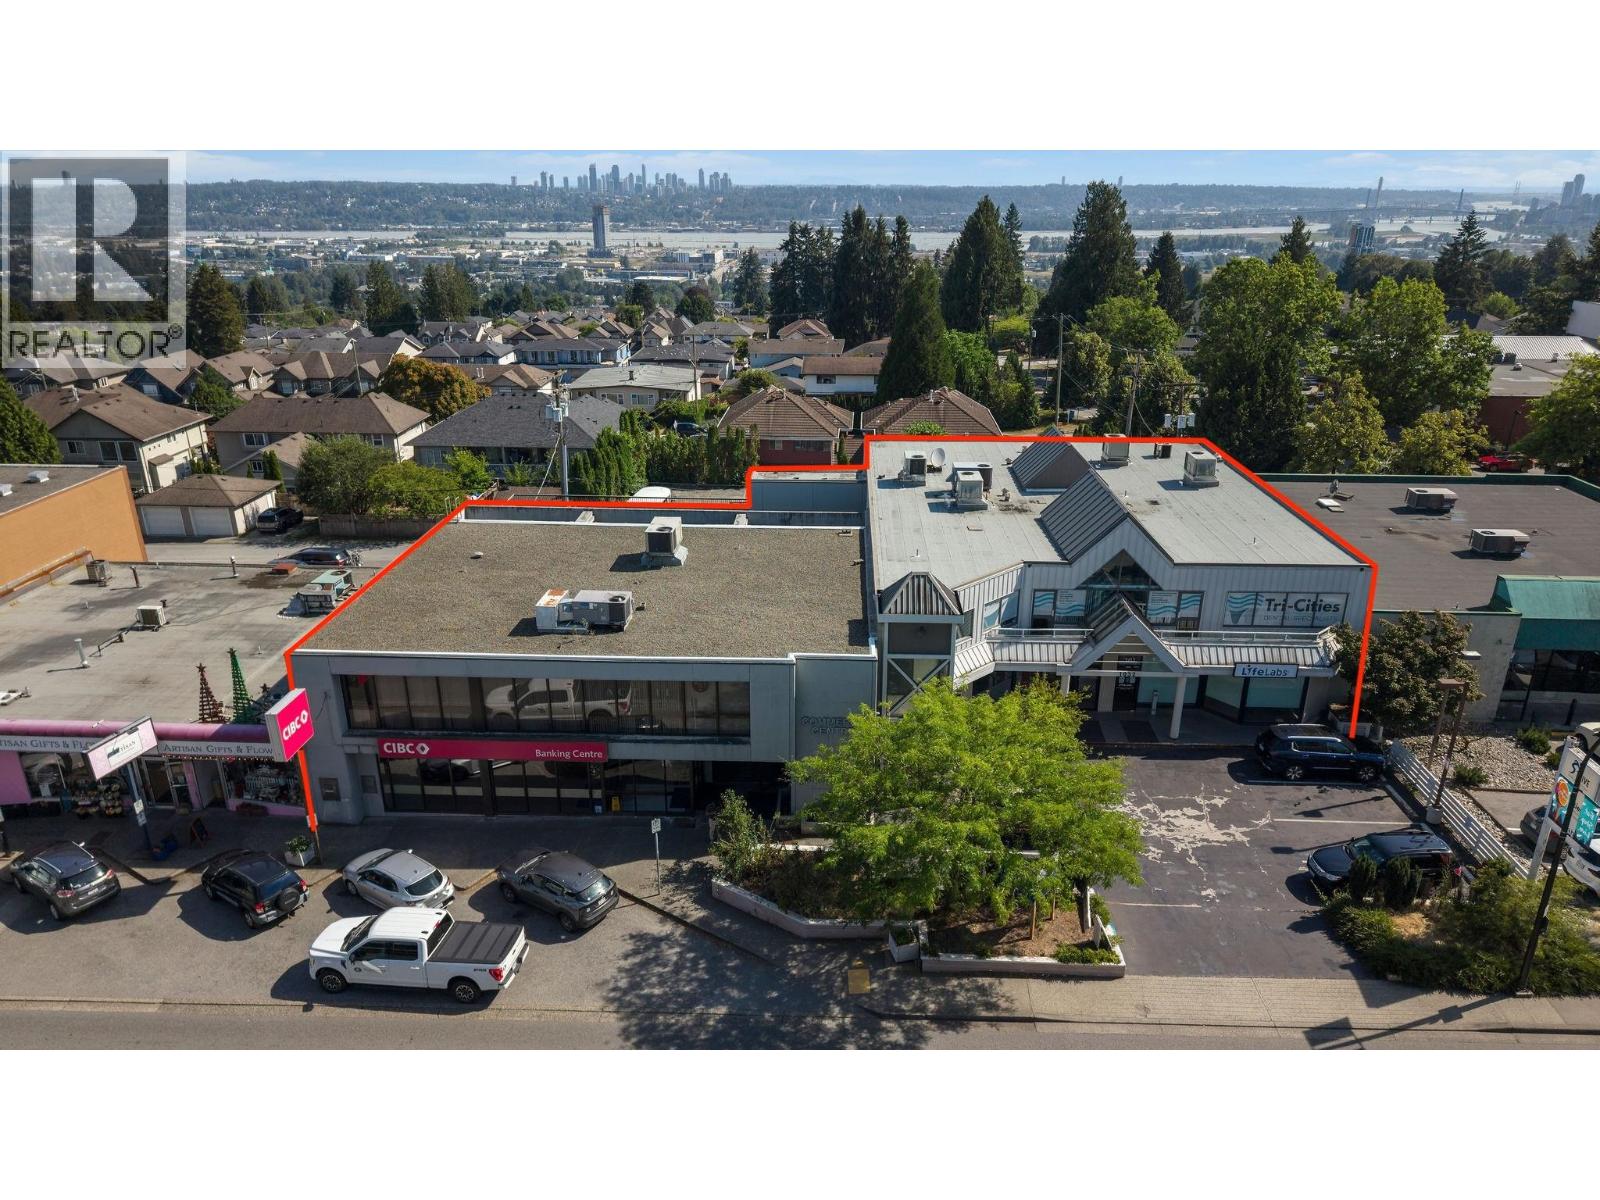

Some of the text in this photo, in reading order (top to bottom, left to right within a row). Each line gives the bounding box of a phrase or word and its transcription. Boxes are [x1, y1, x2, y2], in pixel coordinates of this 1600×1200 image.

[1265, 598, 1340, 613] Tri-Cities
[1242, 665, 1287, 676] LifeLabs
[282, 714, 301, 740] CIBC
[30, 739, 60, 748] GIFTS
[164, 743, 199, 753] ARTISAN
[206, 744, 232, 753] GIFTS
[234, 745, 243, 754] &
[383, 742, 603, 760] CIBC Banking Centre
